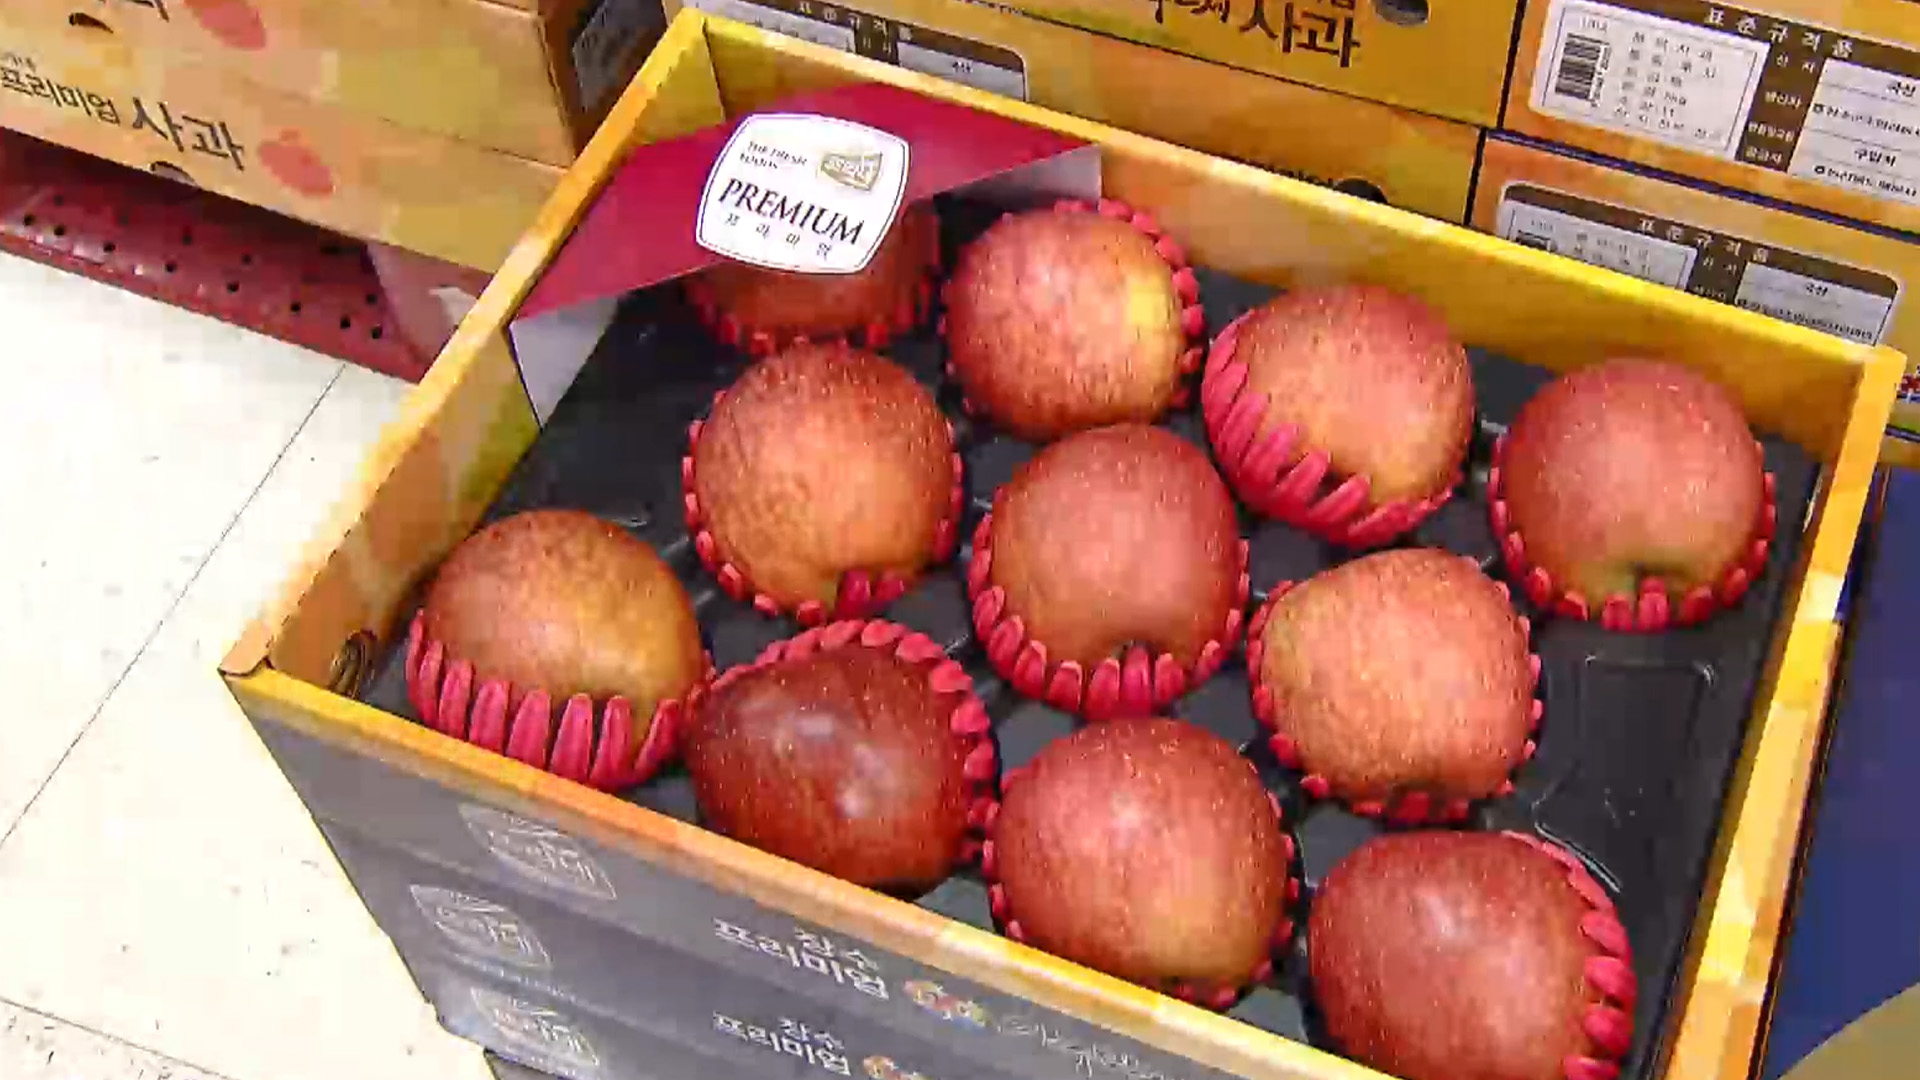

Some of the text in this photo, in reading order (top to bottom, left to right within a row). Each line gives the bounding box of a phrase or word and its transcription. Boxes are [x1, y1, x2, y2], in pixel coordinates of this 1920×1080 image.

[0, 66, 244, 171] 프리미엄 사과
[718, 177, 866, 246] PREMIUM
[712, 917, 890, 1000] 프리미엄
[712, 1010, 851, 1076] 프리미엄
